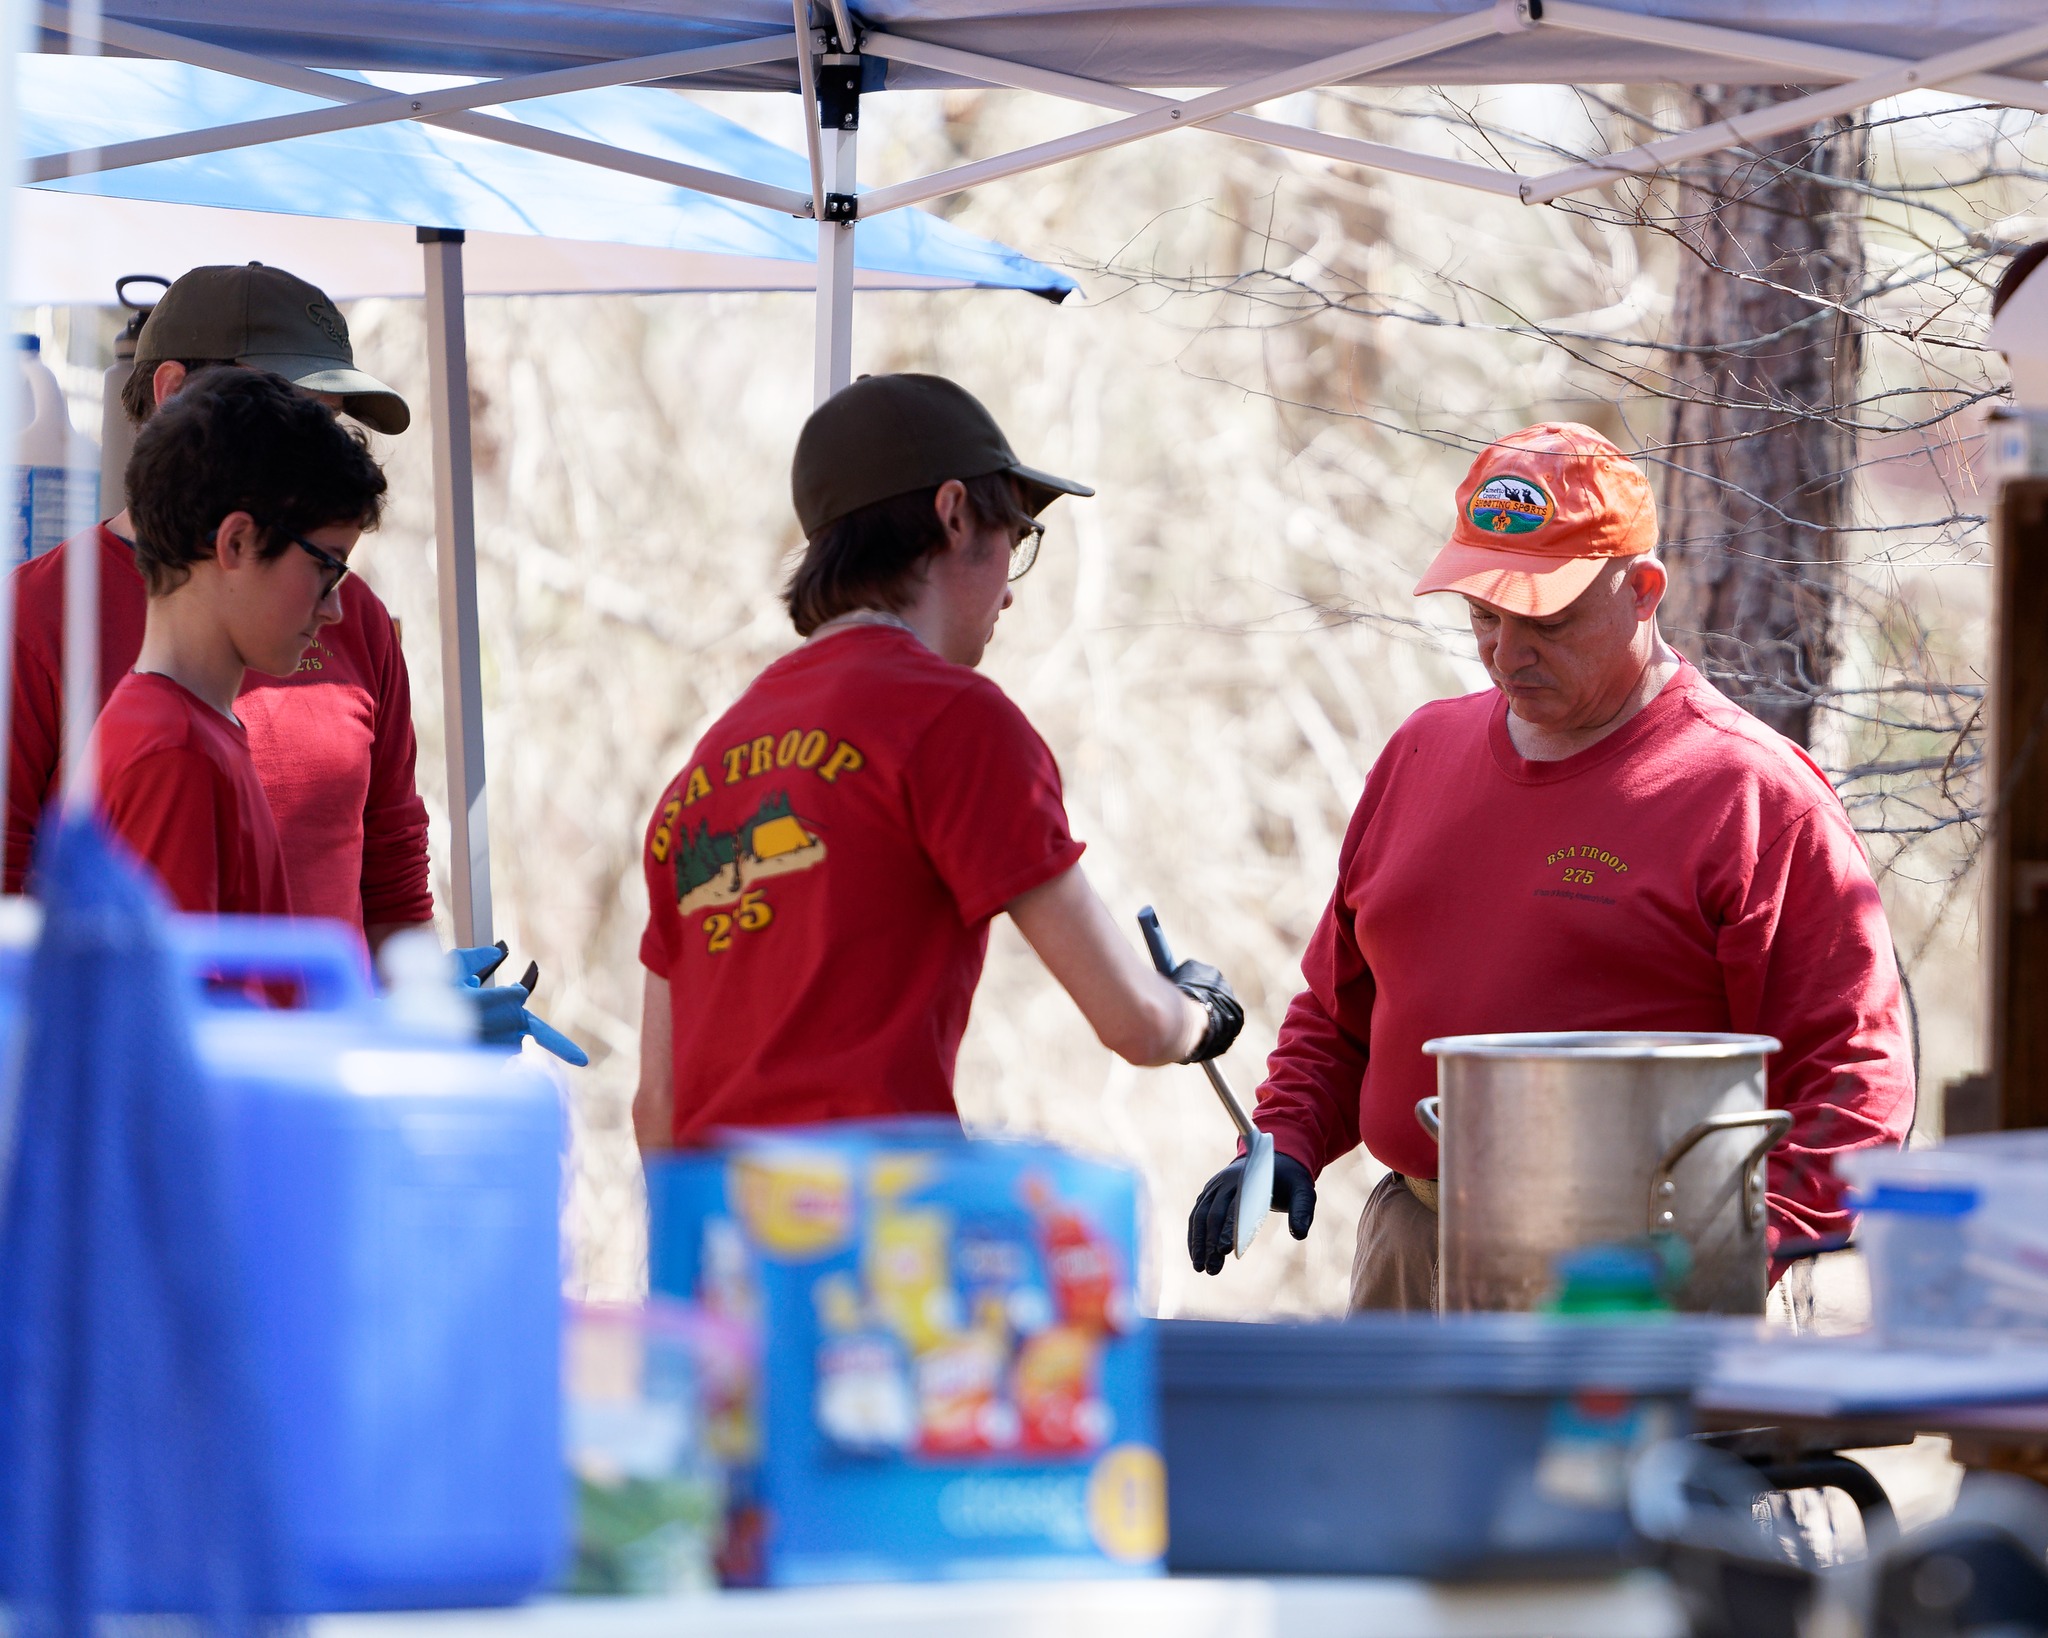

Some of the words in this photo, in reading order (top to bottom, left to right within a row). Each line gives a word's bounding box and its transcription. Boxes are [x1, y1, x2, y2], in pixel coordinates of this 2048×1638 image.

[1475, 500, 1511, 509] SHOOTING
[1513, 503, 1547, 516] SPORTS
[722, 728, 864, 784] TROOP
[1546, 846, 1576, 865] BSA
[1580, 845, 1628, 873] TROOP
[1562, 868, 1595, 885] 275
[702, 887, 773, 954] 25
